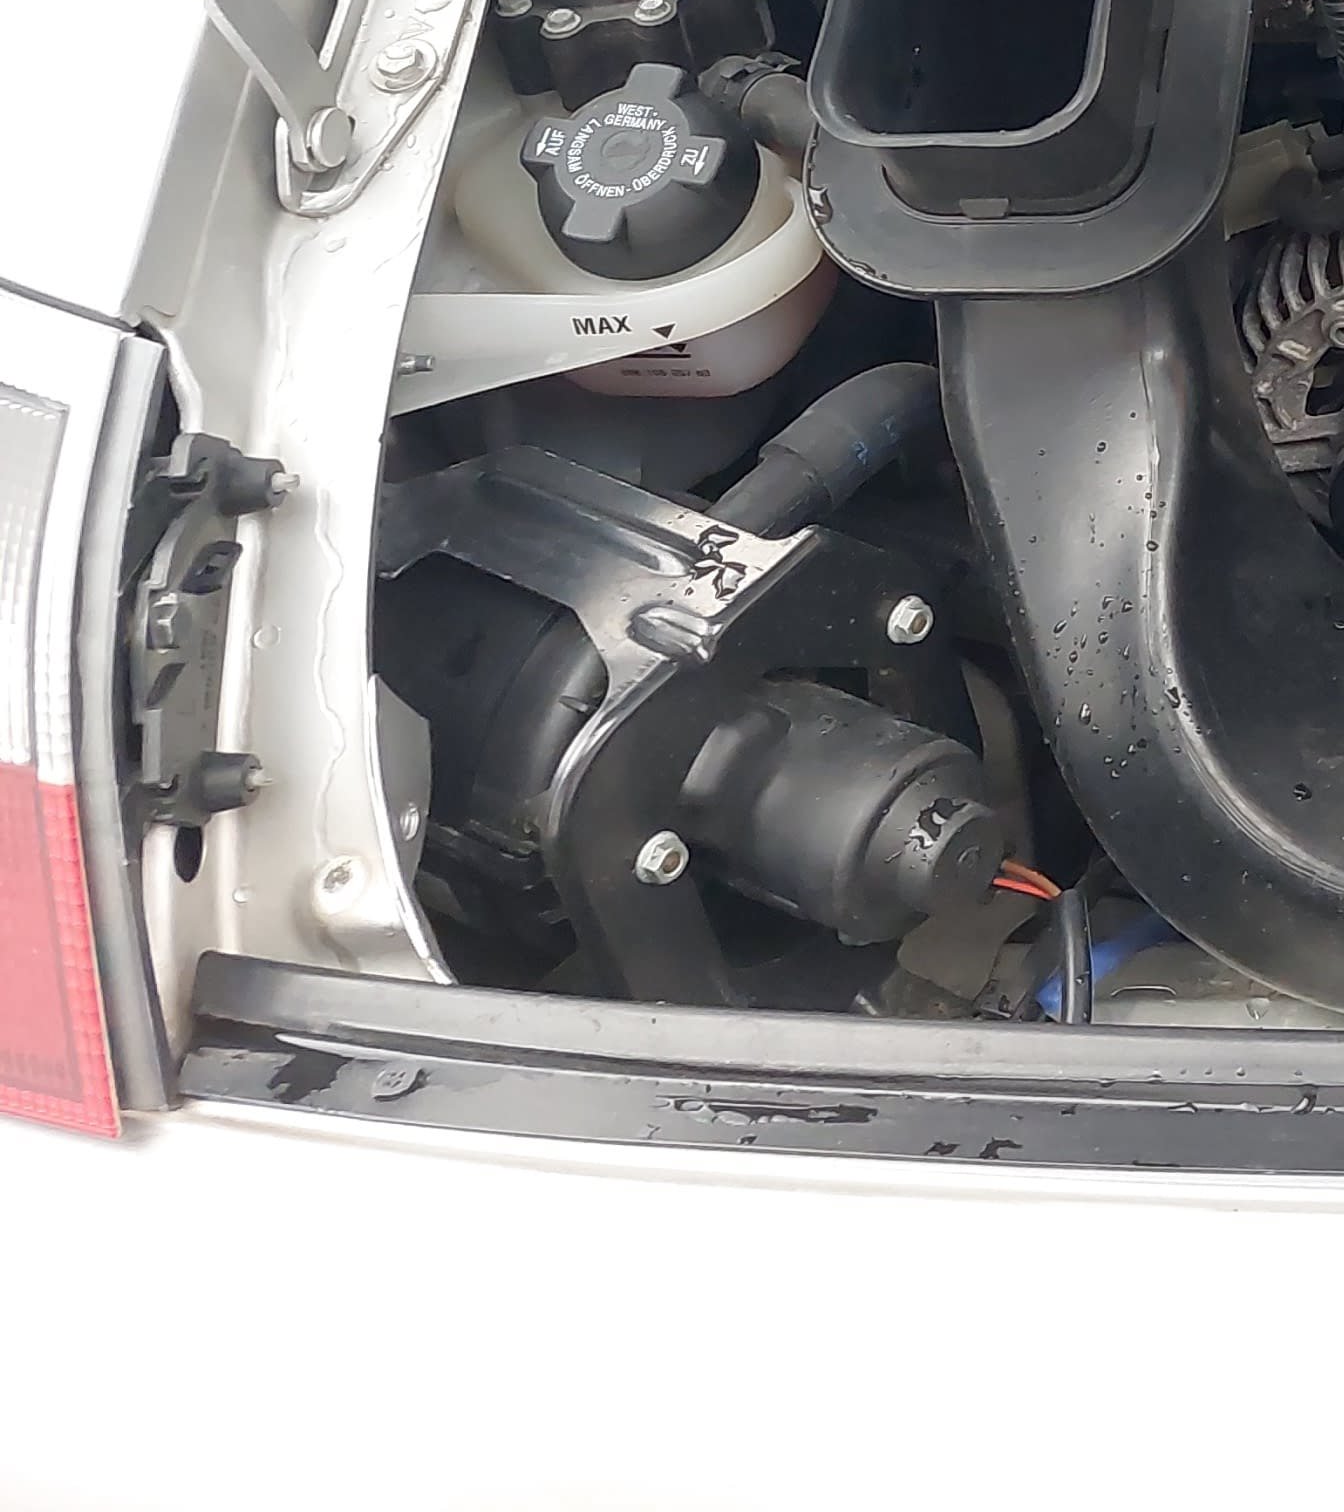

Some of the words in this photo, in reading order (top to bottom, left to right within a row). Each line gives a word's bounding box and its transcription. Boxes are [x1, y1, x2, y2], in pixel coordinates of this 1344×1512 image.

[603, 114, 668, 133] GERMANY
[546, 129, 566, 157] AUF
[565, 118, 603, 174] LANGSAM
[680, 148, 700, 167] ZU
[574, 171, 626, 198] ÖFFNEN
[572, 315, 632, 337] MAX
